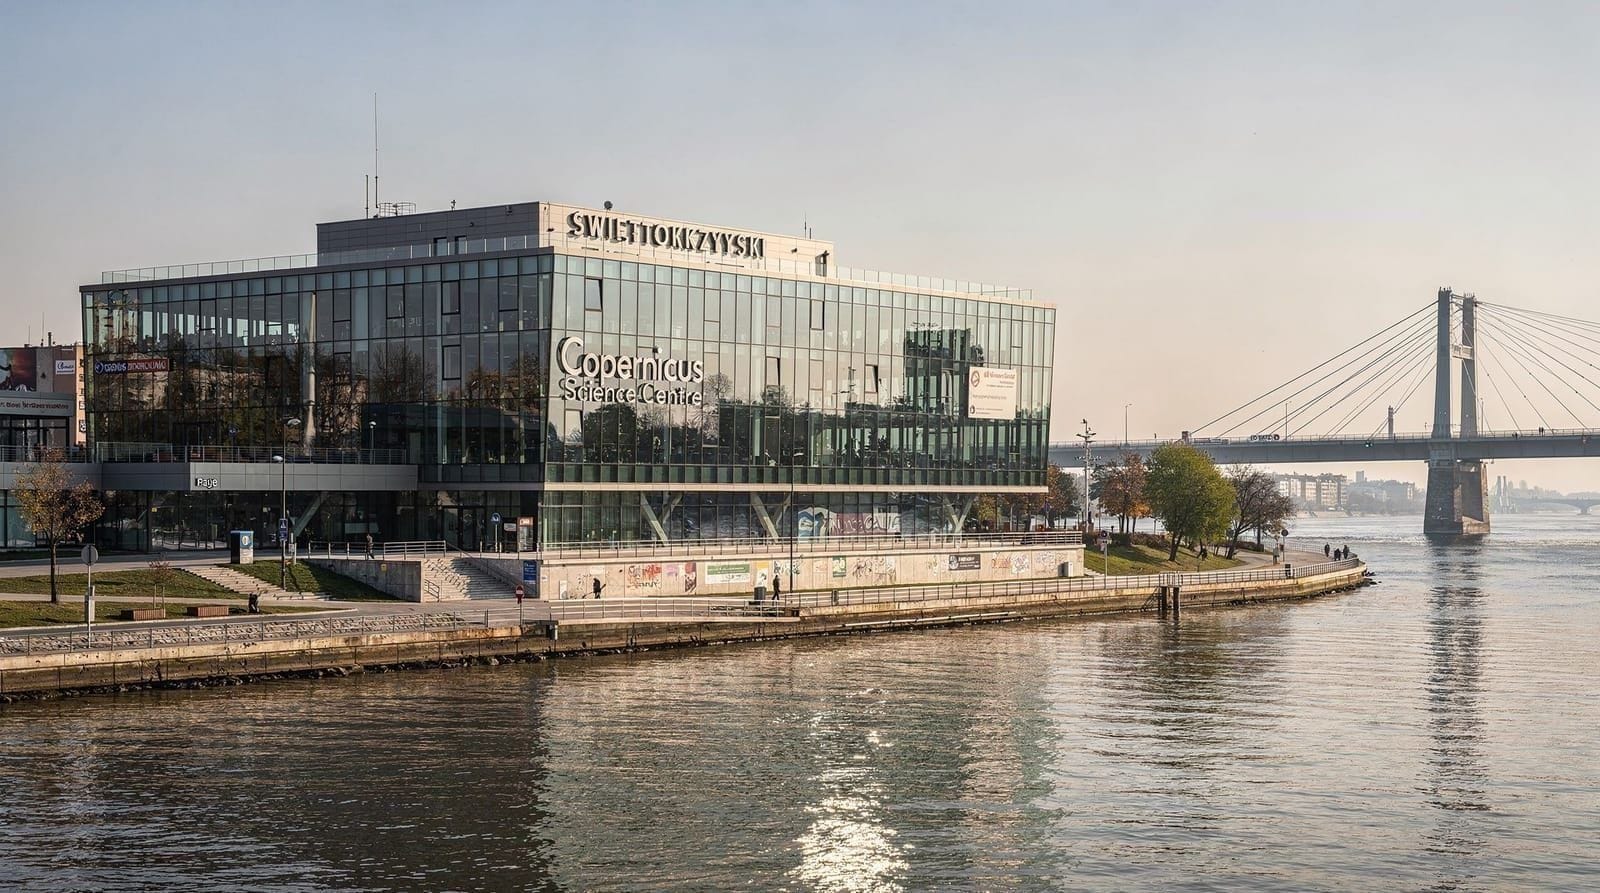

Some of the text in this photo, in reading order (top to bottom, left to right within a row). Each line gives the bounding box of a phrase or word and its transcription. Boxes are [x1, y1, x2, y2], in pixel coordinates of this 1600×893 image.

[558, 336, 703, 385] Copernicus
[562, 377, 702, 405] Science Centre
